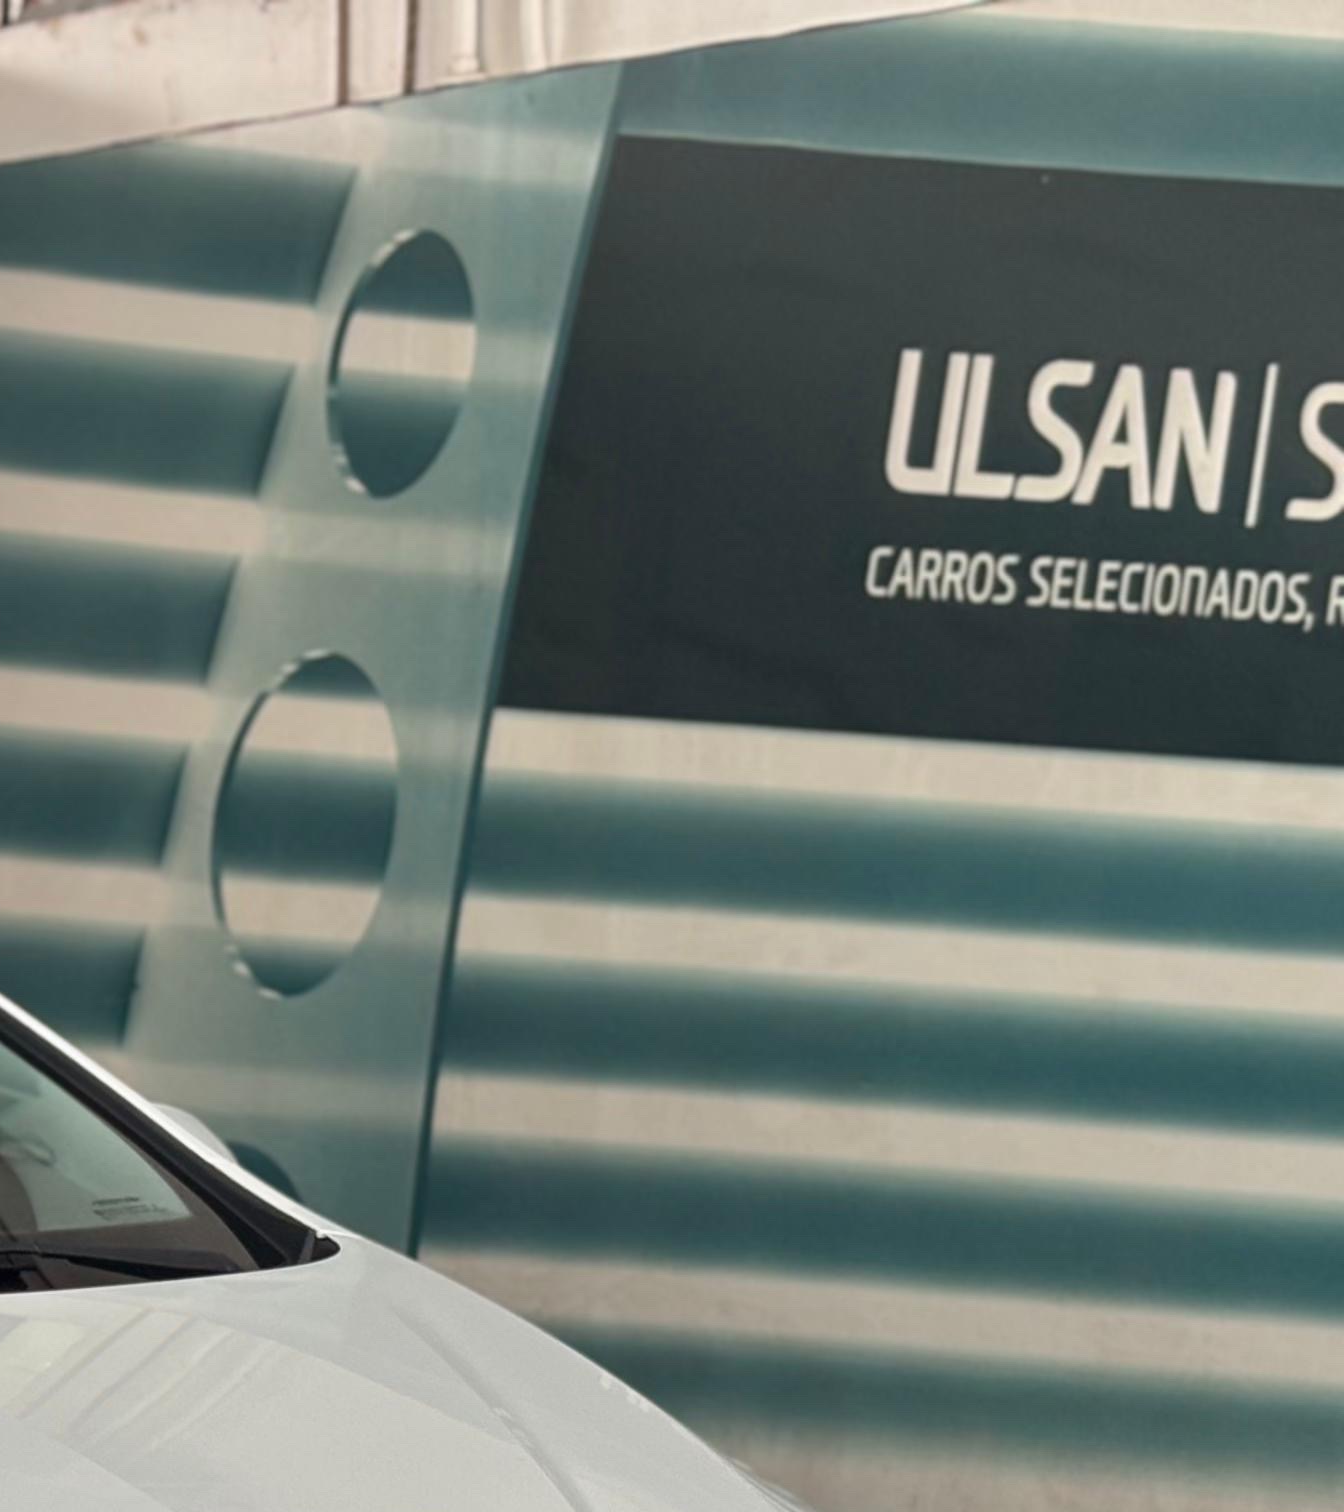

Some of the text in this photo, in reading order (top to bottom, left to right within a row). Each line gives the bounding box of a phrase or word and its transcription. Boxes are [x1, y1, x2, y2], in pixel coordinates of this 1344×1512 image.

[885, 348, 1239, 515] ULSAN
[865, 545, 1020, 604] CARROS
[1025, 555, 1315, 633] SELECIONADOS,
